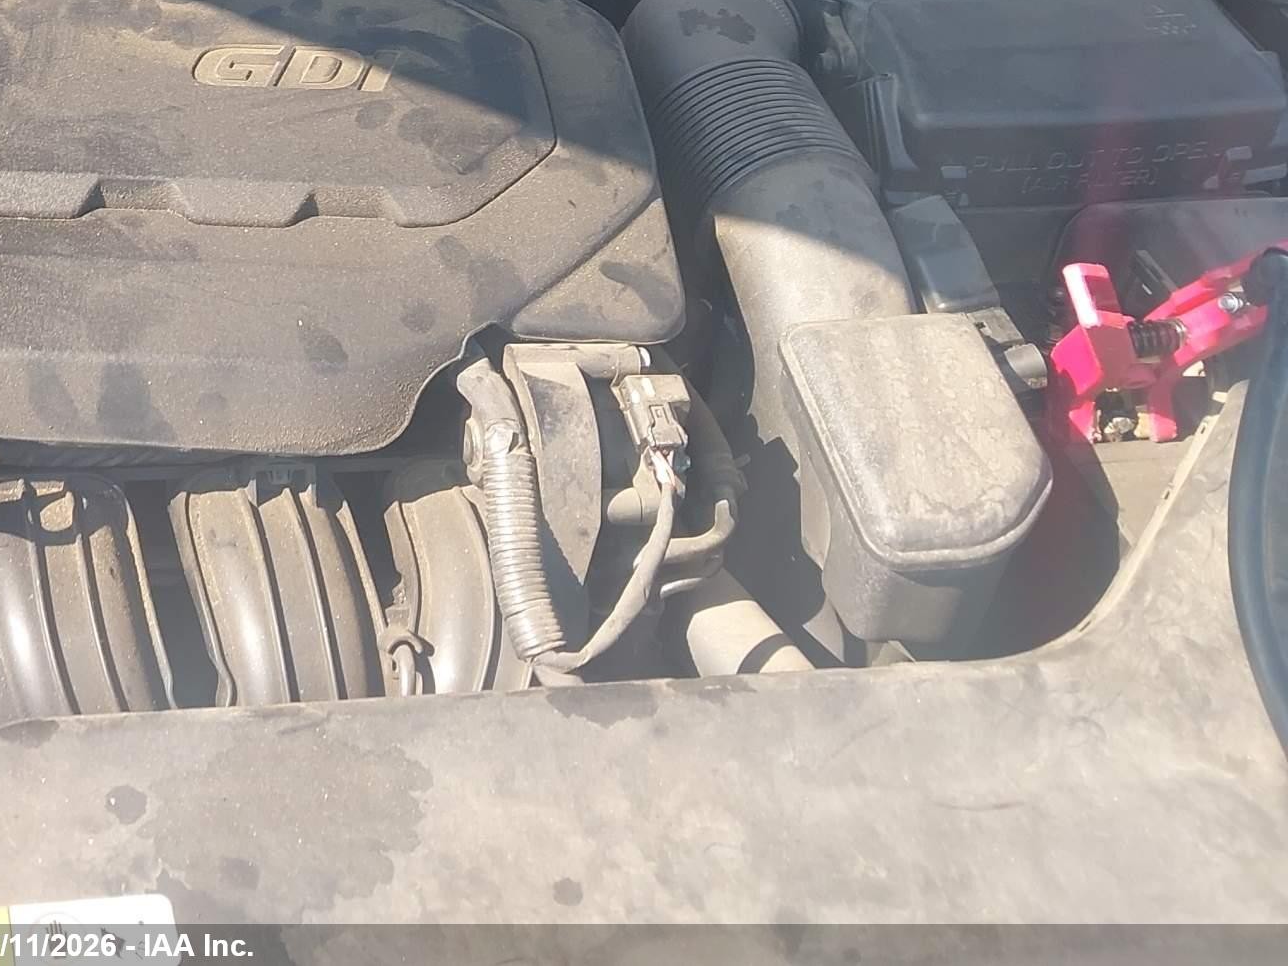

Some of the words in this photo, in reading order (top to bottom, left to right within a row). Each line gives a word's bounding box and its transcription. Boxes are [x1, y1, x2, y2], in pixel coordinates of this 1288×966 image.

[191, 43, 401, 92] GDI
[971, 153, 1039, 172] PULL
[1047, 146, 1105, 170] OUT
[1111, 145, 1145, 166] TO
